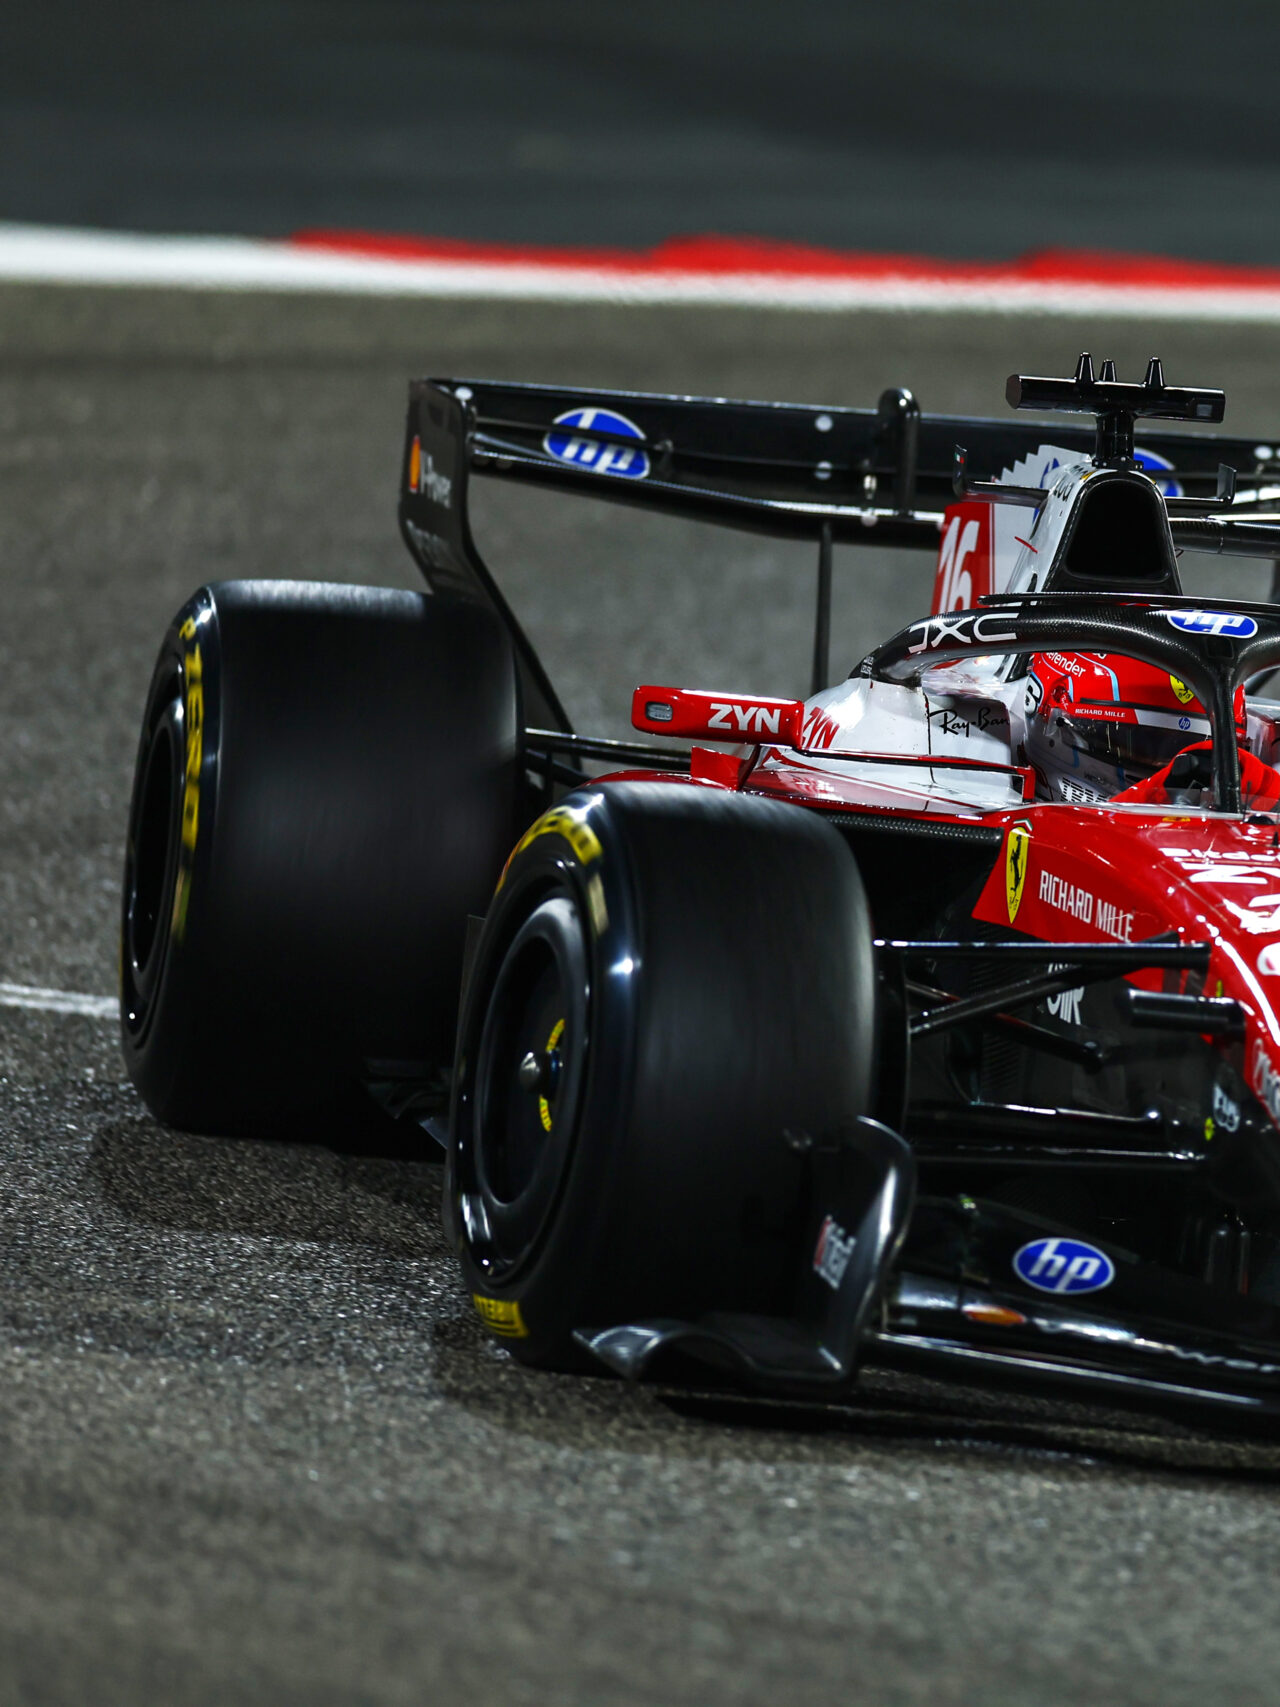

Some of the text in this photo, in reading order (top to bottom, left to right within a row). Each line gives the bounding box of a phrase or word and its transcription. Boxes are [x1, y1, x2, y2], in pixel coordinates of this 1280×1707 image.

[560, 408, 637, 475] hp
[937, 515, 980, 614] 16
[908, 612, 1019, 654] DXC
[707, 702, 782, 734] ZYN
[927, 706, 1010, 738] Ray-Ban
[1074, 707, 1126, 718] RICHARD MILLE
[1179, 717, 1190, 730] hp
[1039, 869, 1134, 944] RICHARD MILLE
[1028, 1238, 1101, 1292] hp
